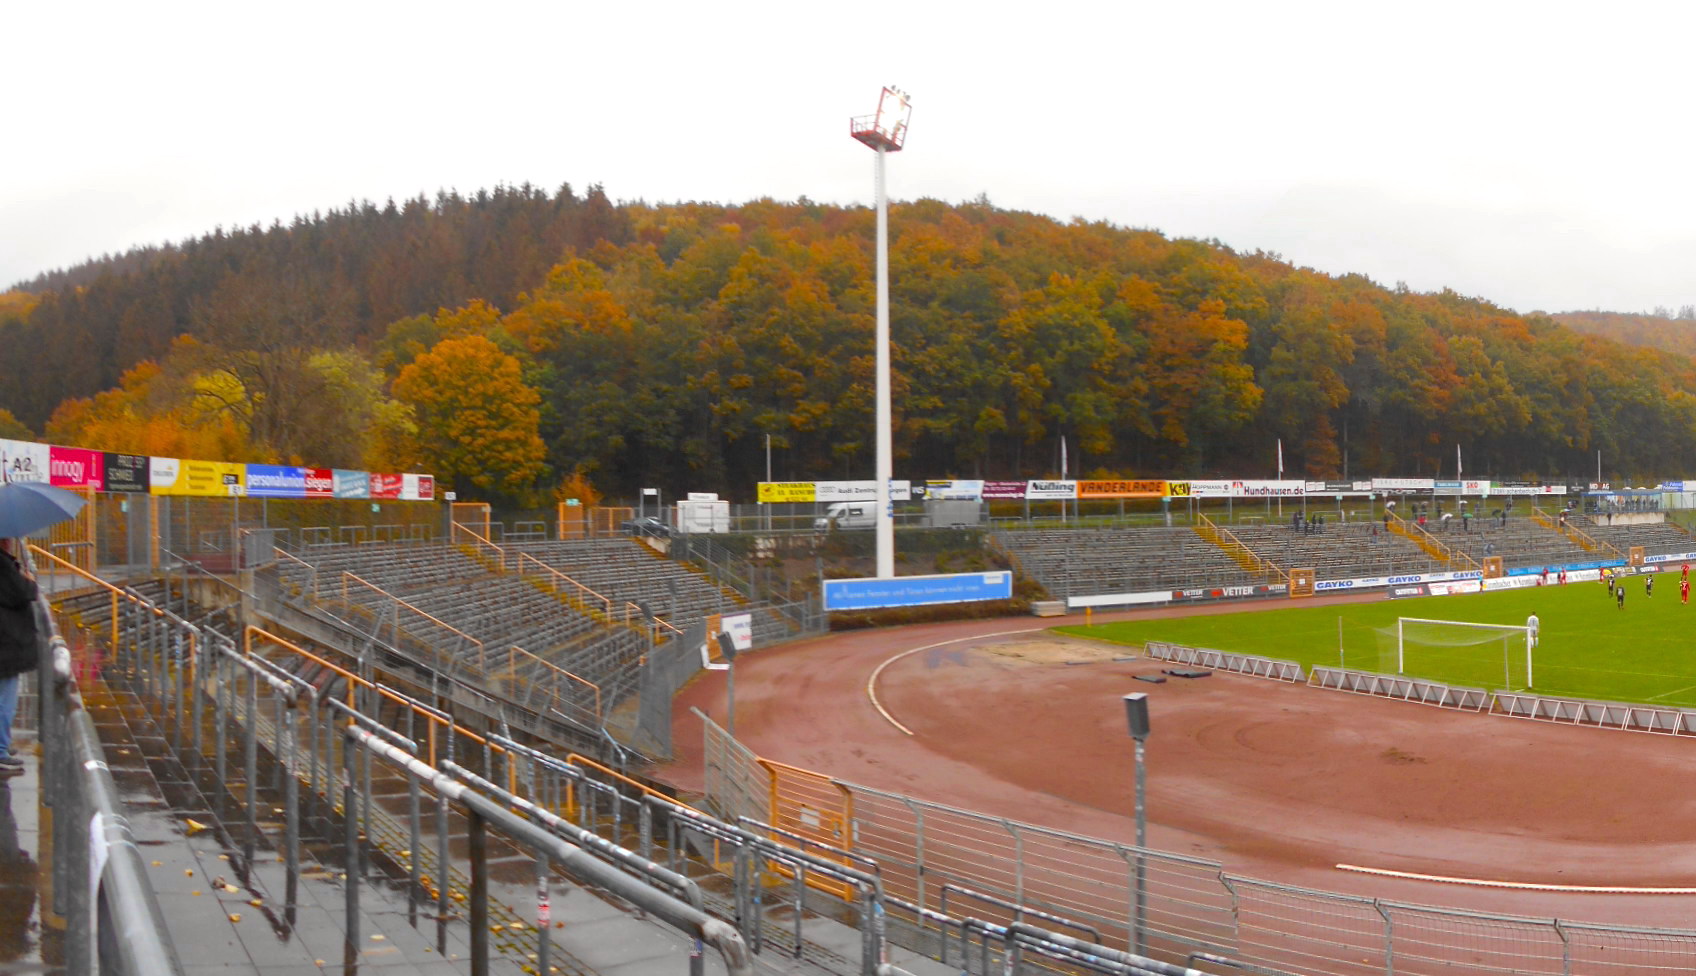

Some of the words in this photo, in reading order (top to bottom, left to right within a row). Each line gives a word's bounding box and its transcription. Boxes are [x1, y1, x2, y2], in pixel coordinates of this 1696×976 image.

[50, 453, 85, 483] innogy
[1081, 482, 1162, 493] VANDERLANDE
[1244, 486, 1304, 496] Hundhausen.de
[1388, 575, 1422, 584] GAYKO
[1453, 570, 1482, 579] GAYKO
[1316, 580, 1354, 589] GAYKO
[1222, 586, 1254, 596] VETTER
